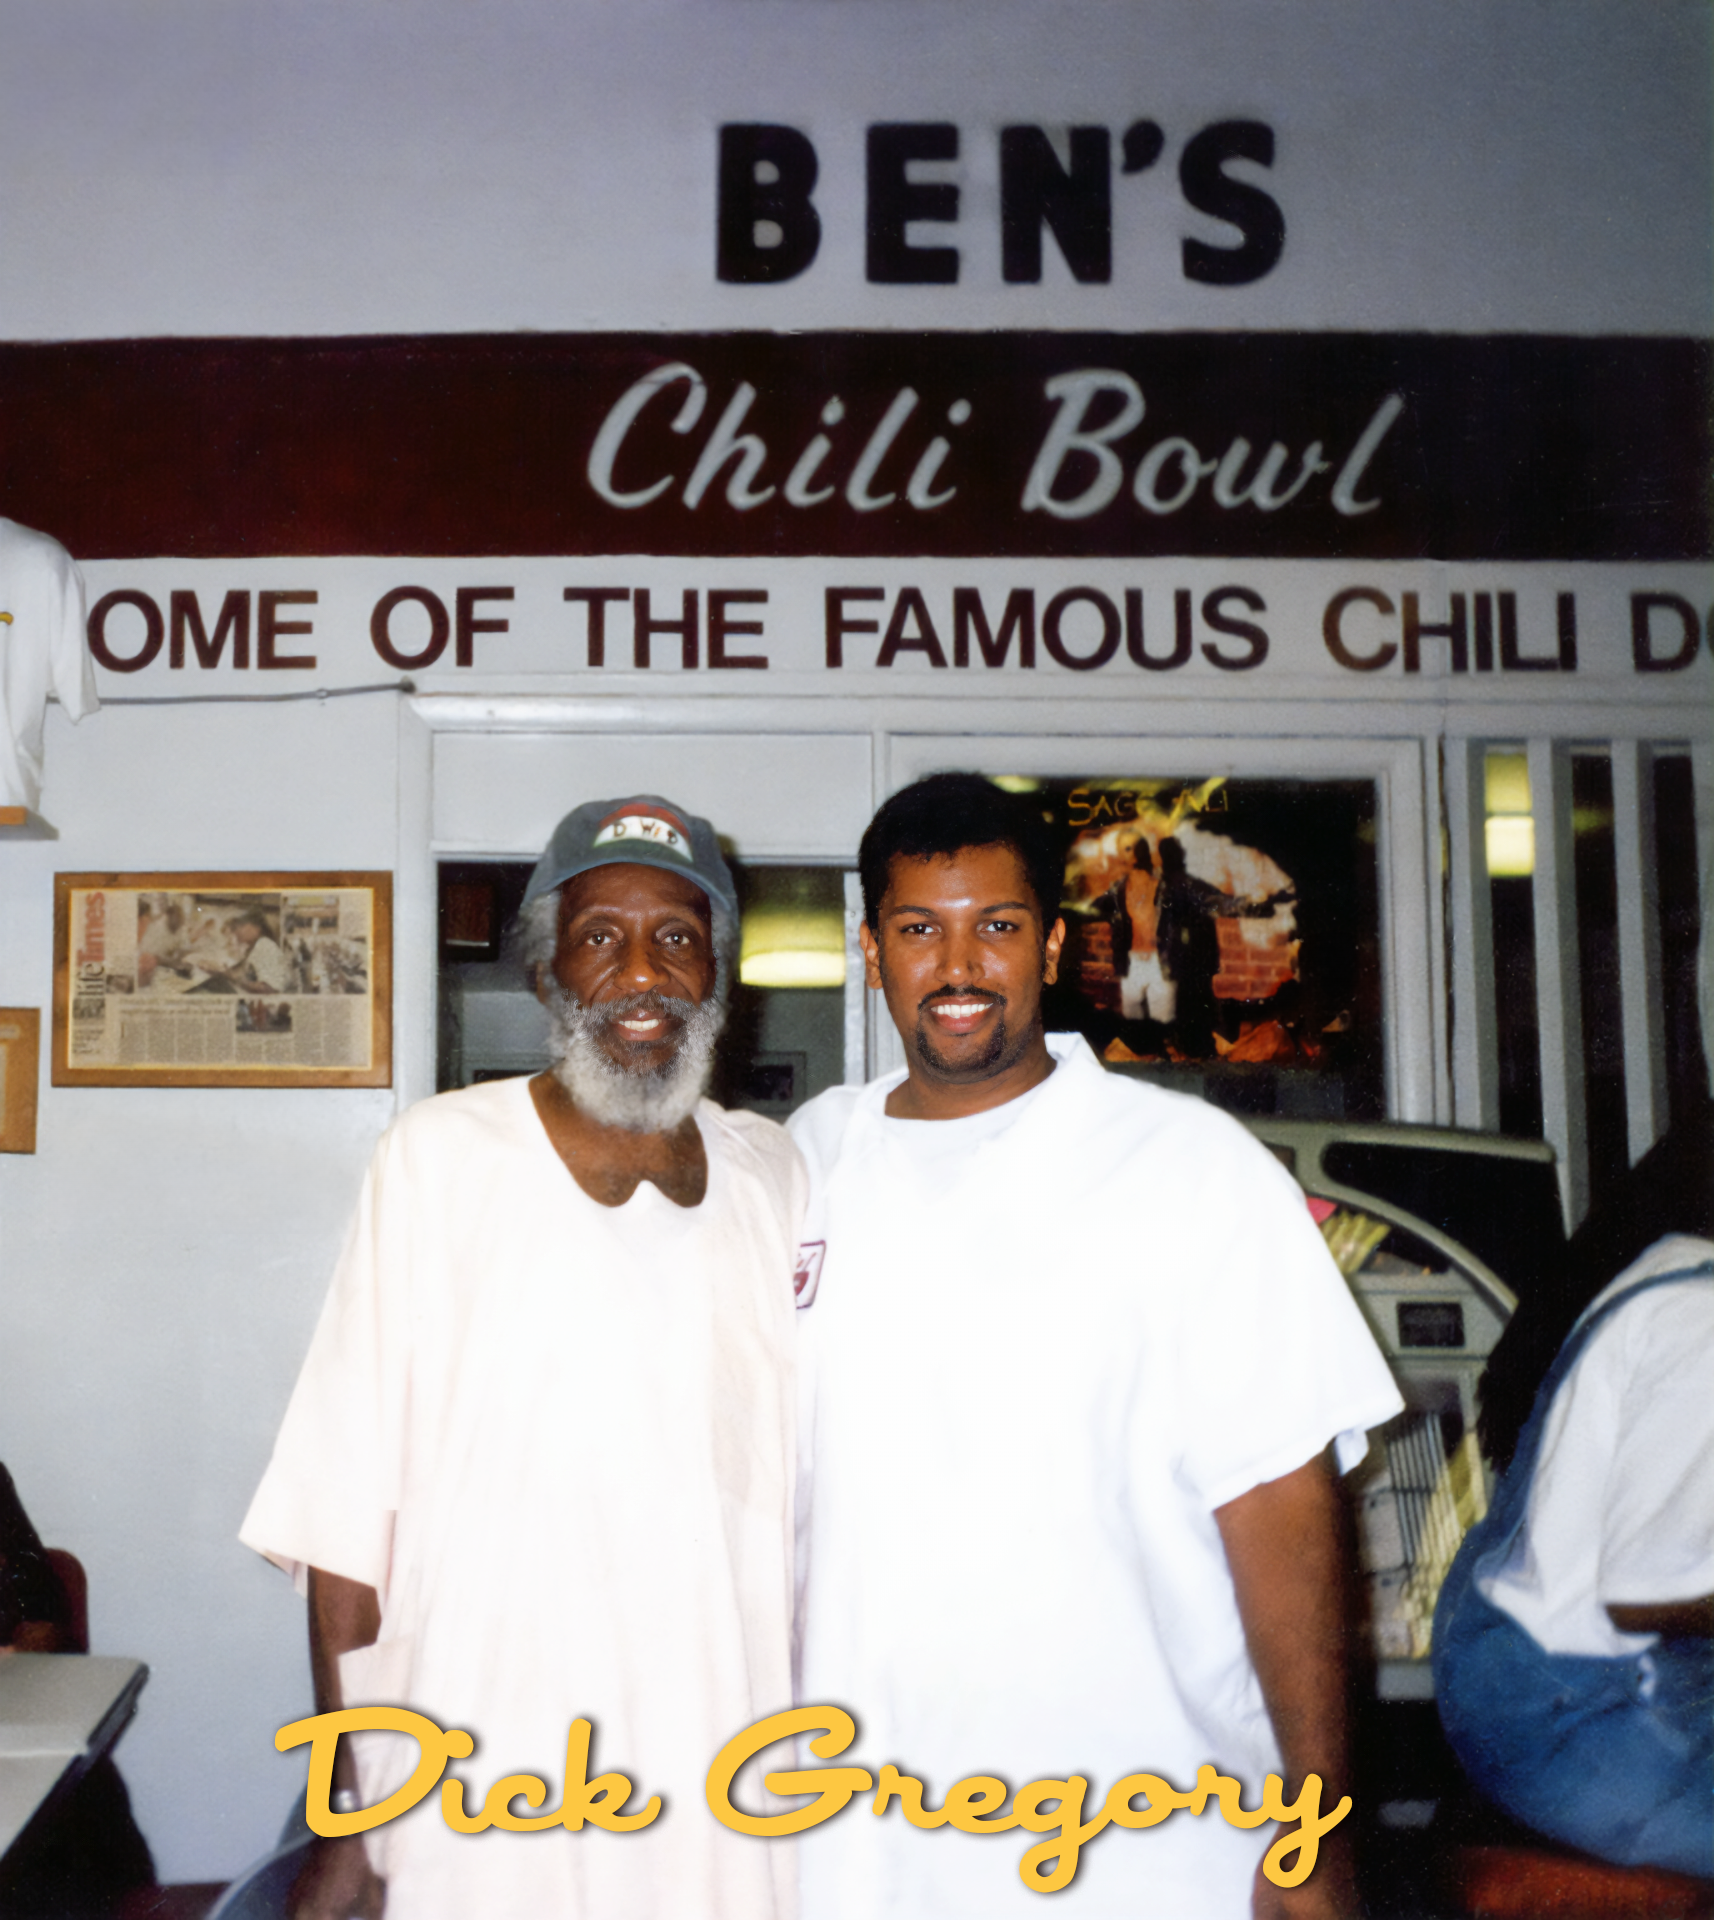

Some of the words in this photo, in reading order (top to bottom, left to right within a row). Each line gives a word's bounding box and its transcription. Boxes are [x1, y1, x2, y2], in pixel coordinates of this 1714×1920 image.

[717, 118, 1286, 286] BEN'S
[588, 363, 970, 510] Chili
[1022, 370, 1401, 517] Bowl
[88, 590, 317, 673] OME
[371, 586, 514, 670] OF
[564, 587, 768, 669] THE
[825, 586, 1269, 671] FAMOUS
[1323, 587, 1578, 674] CHILI
[1628, 589, 1714, 676] D
